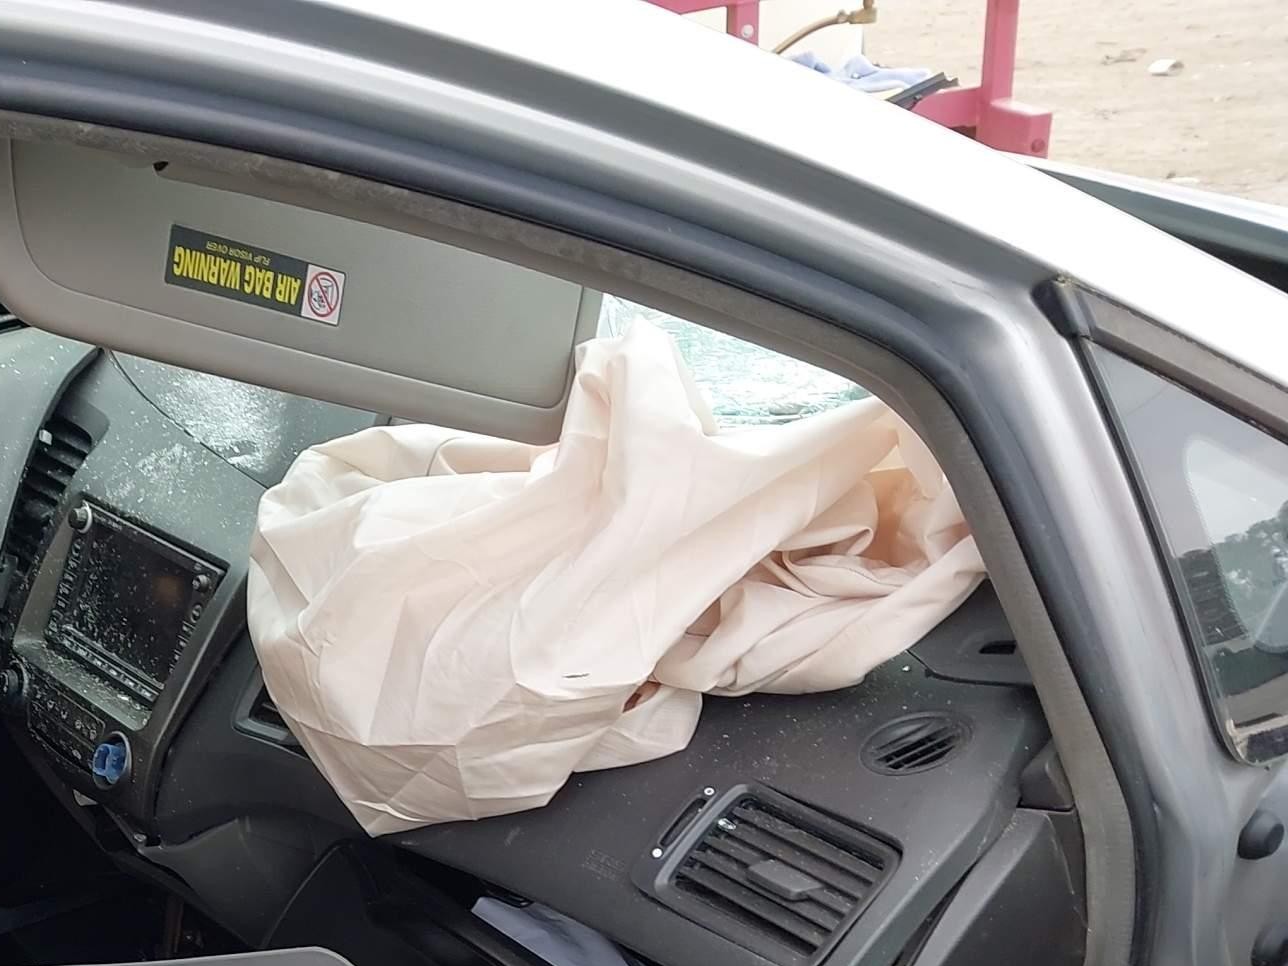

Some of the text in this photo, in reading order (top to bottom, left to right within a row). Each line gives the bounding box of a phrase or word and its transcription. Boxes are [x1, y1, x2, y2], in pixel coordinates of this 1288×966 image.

[206, 241, 229, 254] OVER
[173, 245, 302, 305] AIR BAG WARNING
